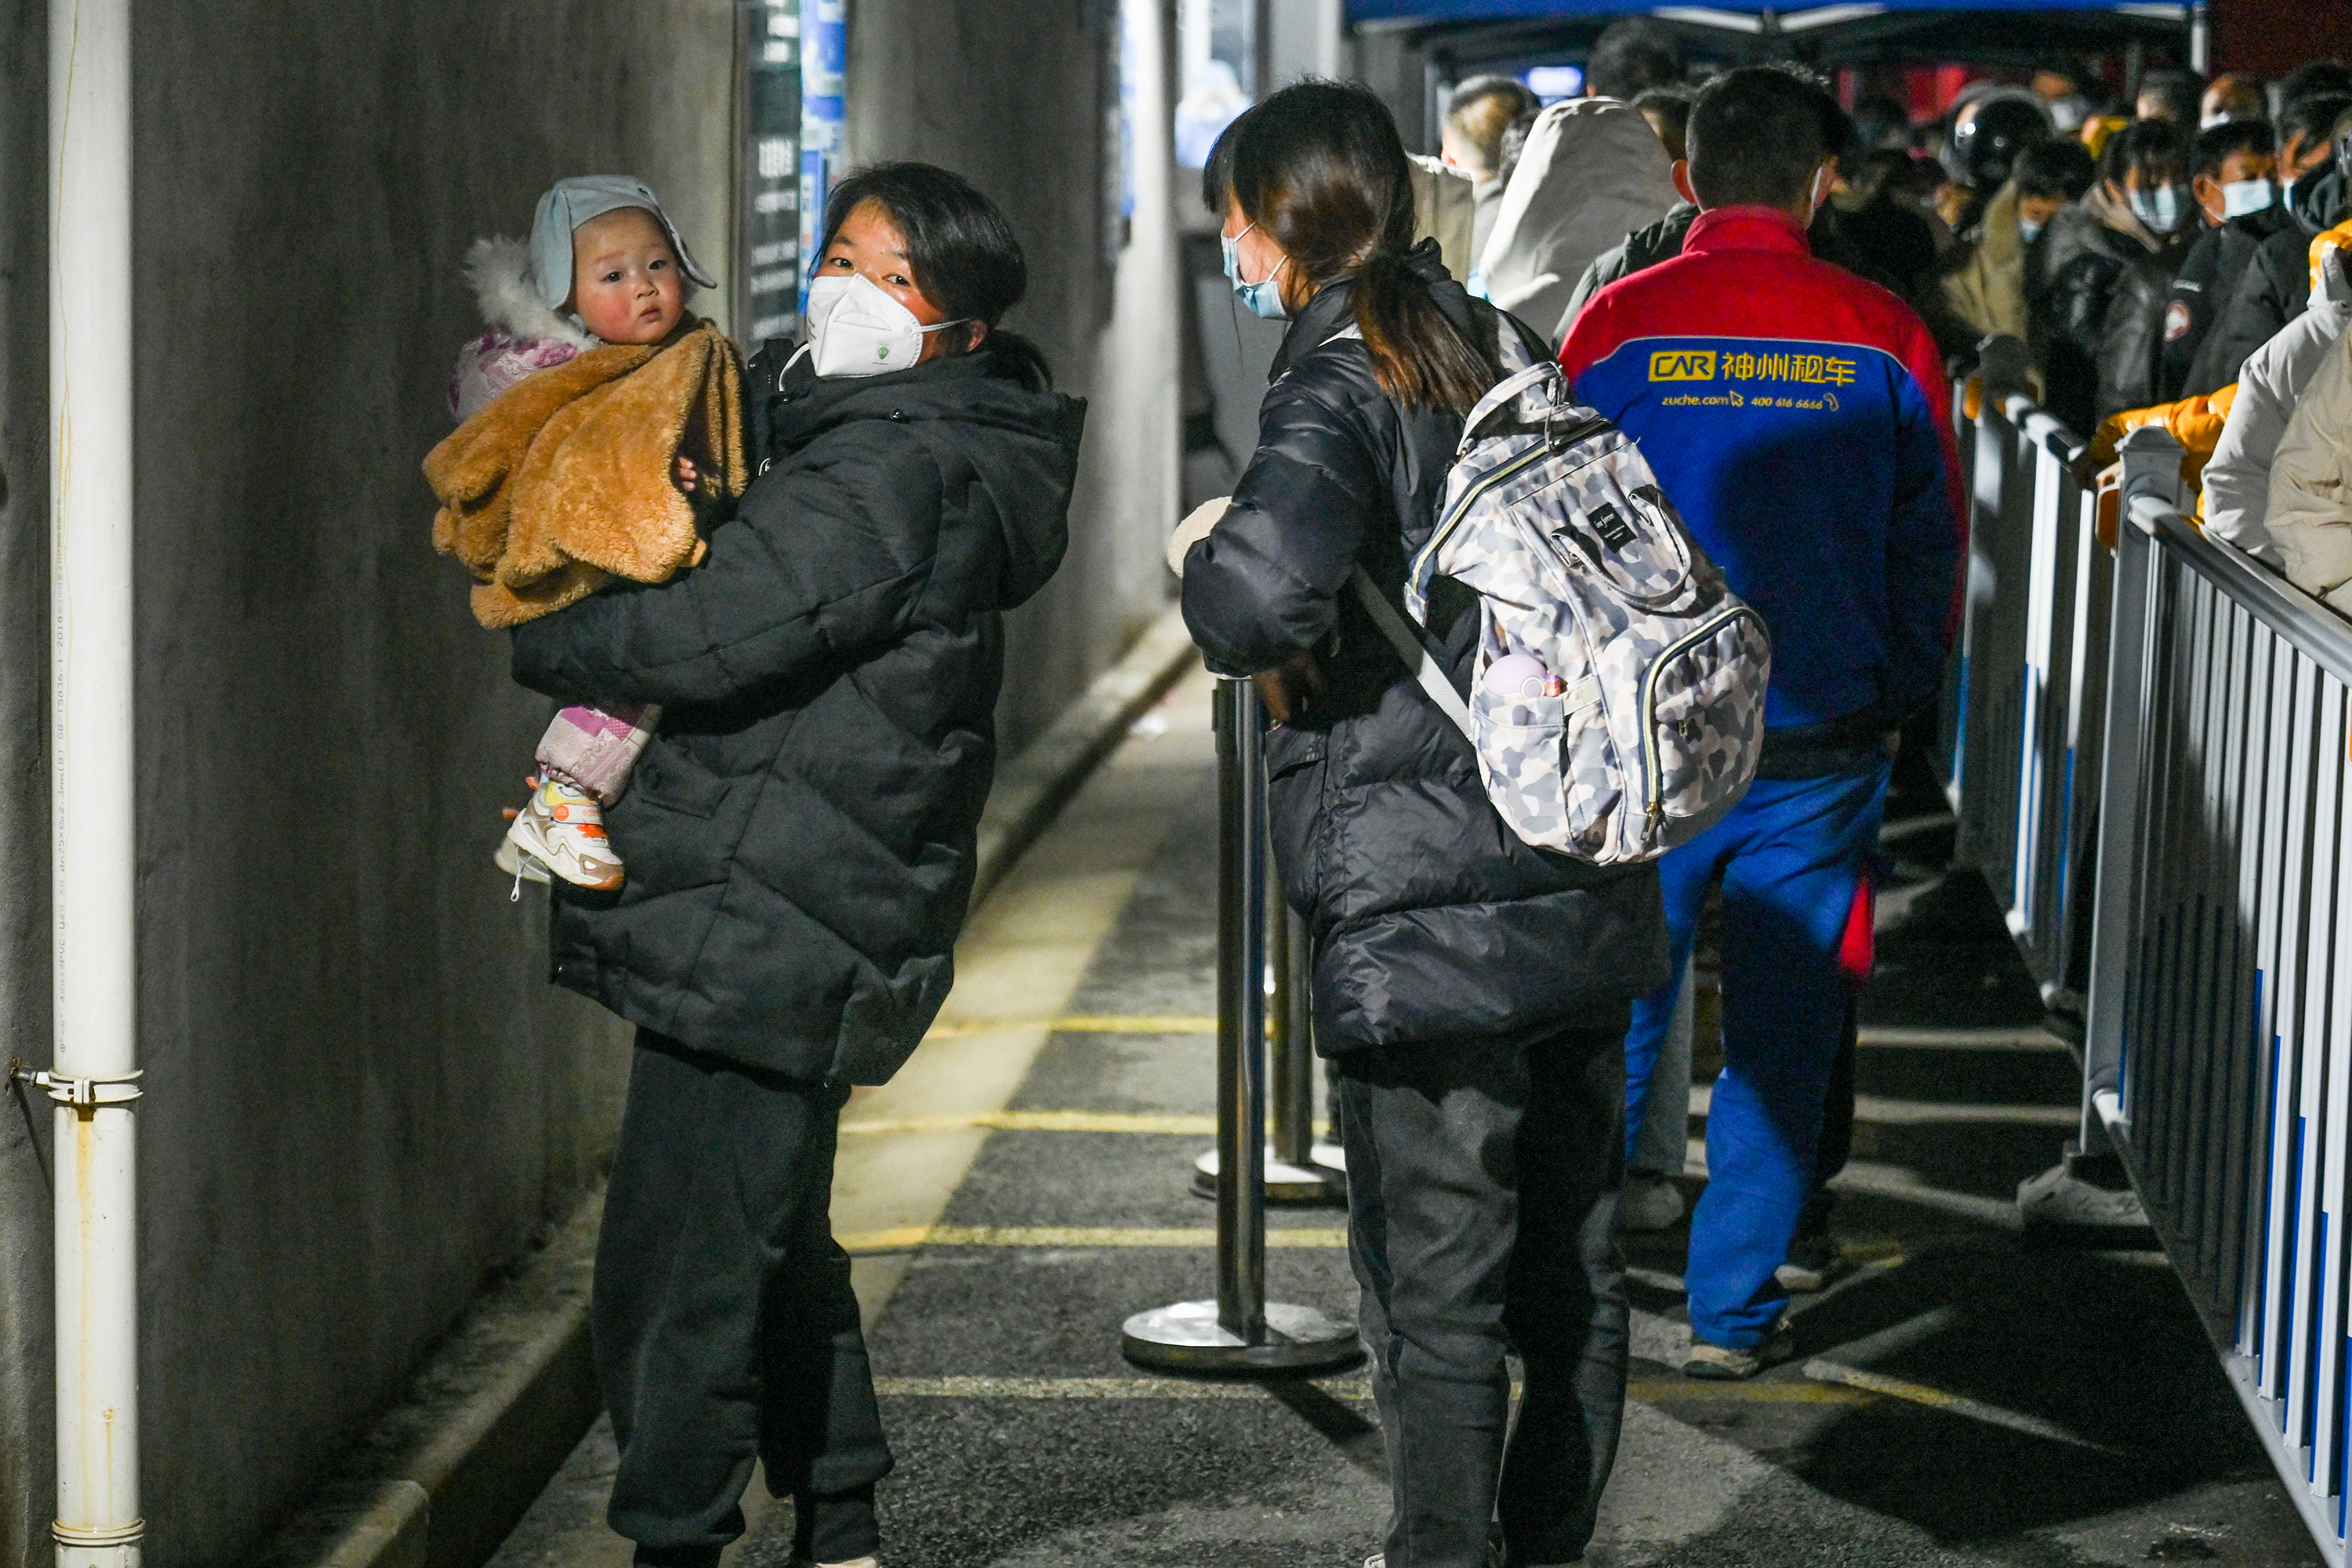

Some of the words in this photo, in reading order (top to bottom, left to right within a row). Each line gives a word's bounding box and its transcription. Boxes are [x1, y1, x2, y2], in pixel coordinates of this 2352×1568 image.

[1654, 355, 1711, 377] CAR
[1722, 352, 1857, 387] 神州租车
[1661, 394, 1729, 406] zuche.com
[1751, 397, 1773, 407] 400
[1775, 397, 1793, 408] 616
[1795, 399, 1824, 409] 6666
